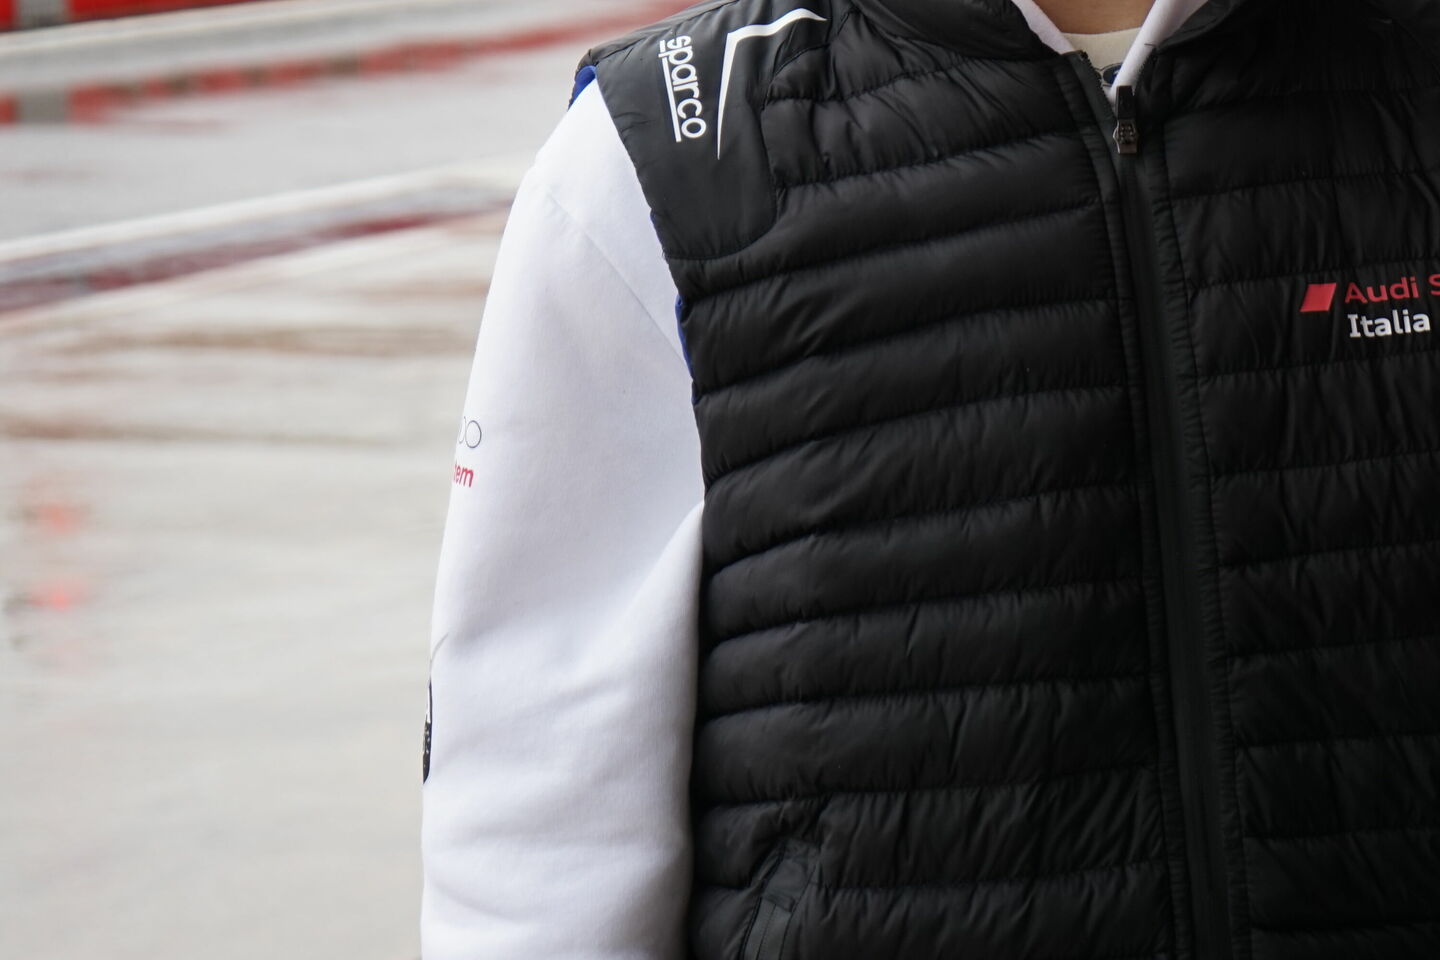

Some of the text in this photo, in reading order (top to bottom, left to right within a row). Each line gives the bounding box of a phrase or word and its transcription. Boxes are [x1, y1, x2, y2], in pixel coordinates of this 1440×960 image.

[657, 35, 707, 141] sparco
[1344, 276, 1420, 304] Audi
[1347, 309, 1431, 338] Italia
